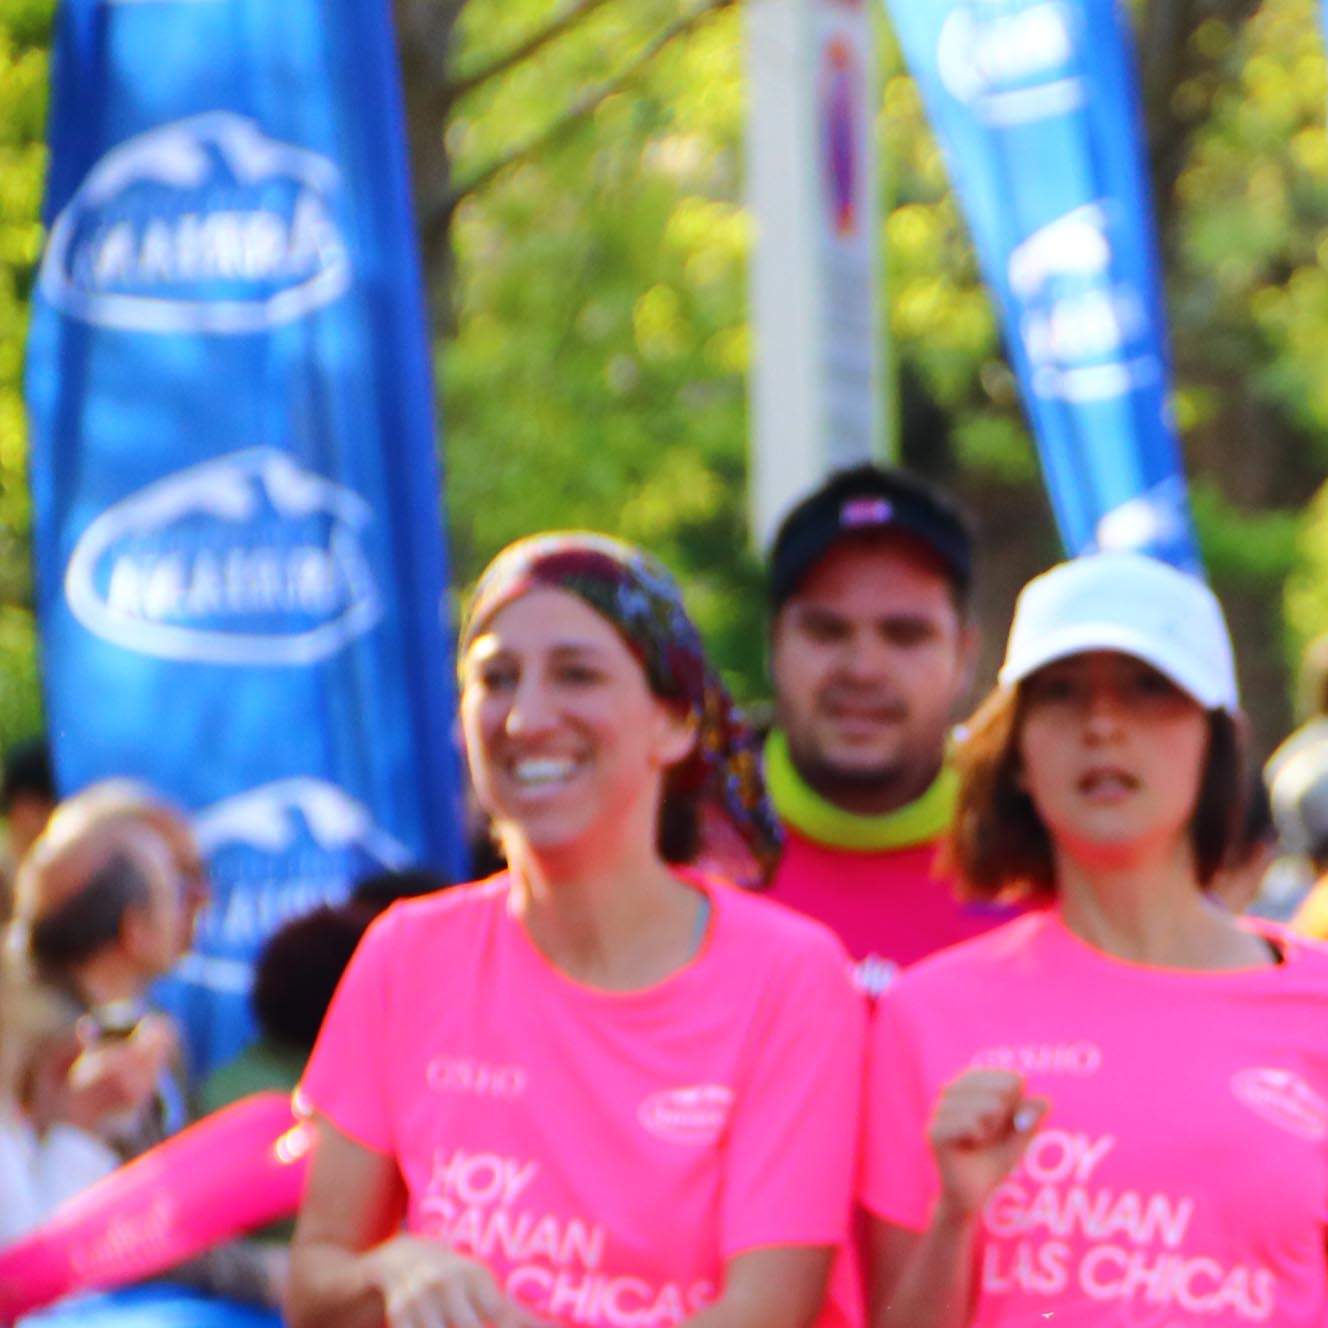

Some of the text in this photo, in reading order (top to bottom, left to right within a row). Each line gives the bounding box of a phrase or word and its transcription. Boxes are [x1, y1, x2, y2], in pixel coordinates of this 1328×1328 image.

[425, 1148, 541, 1209] HOY
[1022, 1129, 1117, 1184] OY
[983, 1184, 1193, 1250] GANAN
[983, 1241, 1275, 1320] LAS CHICAS
